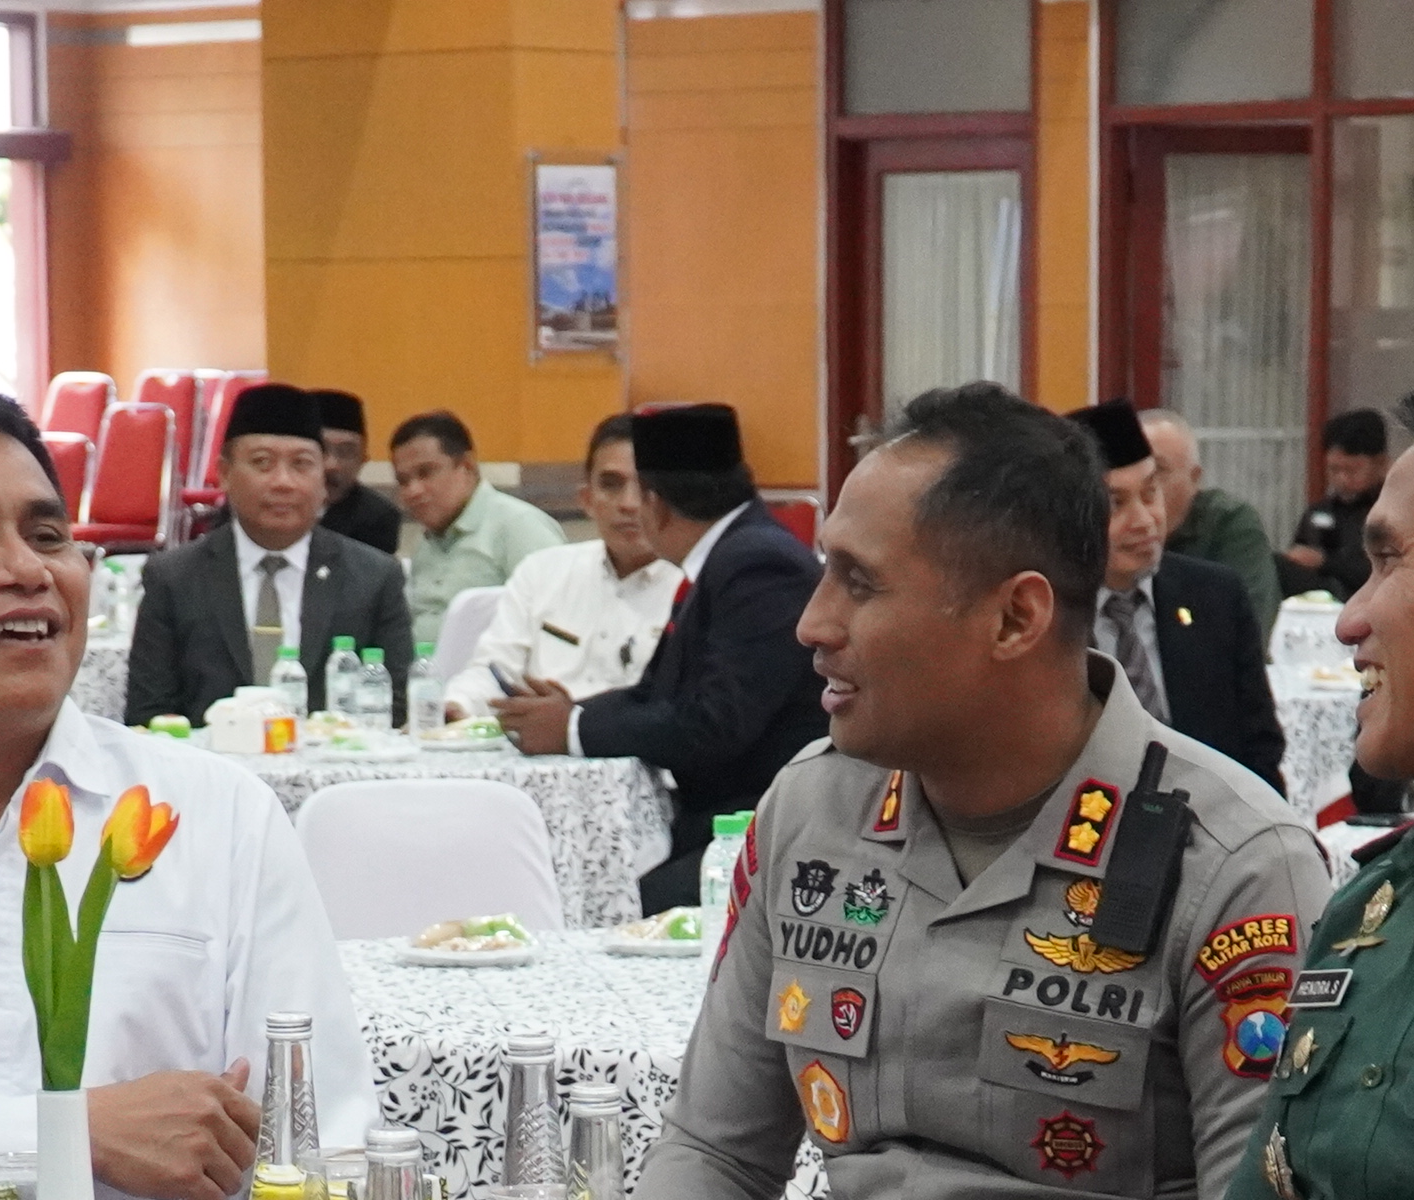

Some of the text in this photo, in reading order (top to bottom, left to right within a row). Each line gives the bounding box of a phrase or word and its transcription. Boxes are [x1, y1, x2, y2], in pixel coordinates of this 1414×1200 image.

[780, 920, 878, 969] YUDHO
[1199, 918, 1289, 964] POLRES
[1206, 933, 1289, 971] BLITAR KOTA
[1002, 967, 1145, 1024] POLRI
[1330, 979, 1341, 995] S
